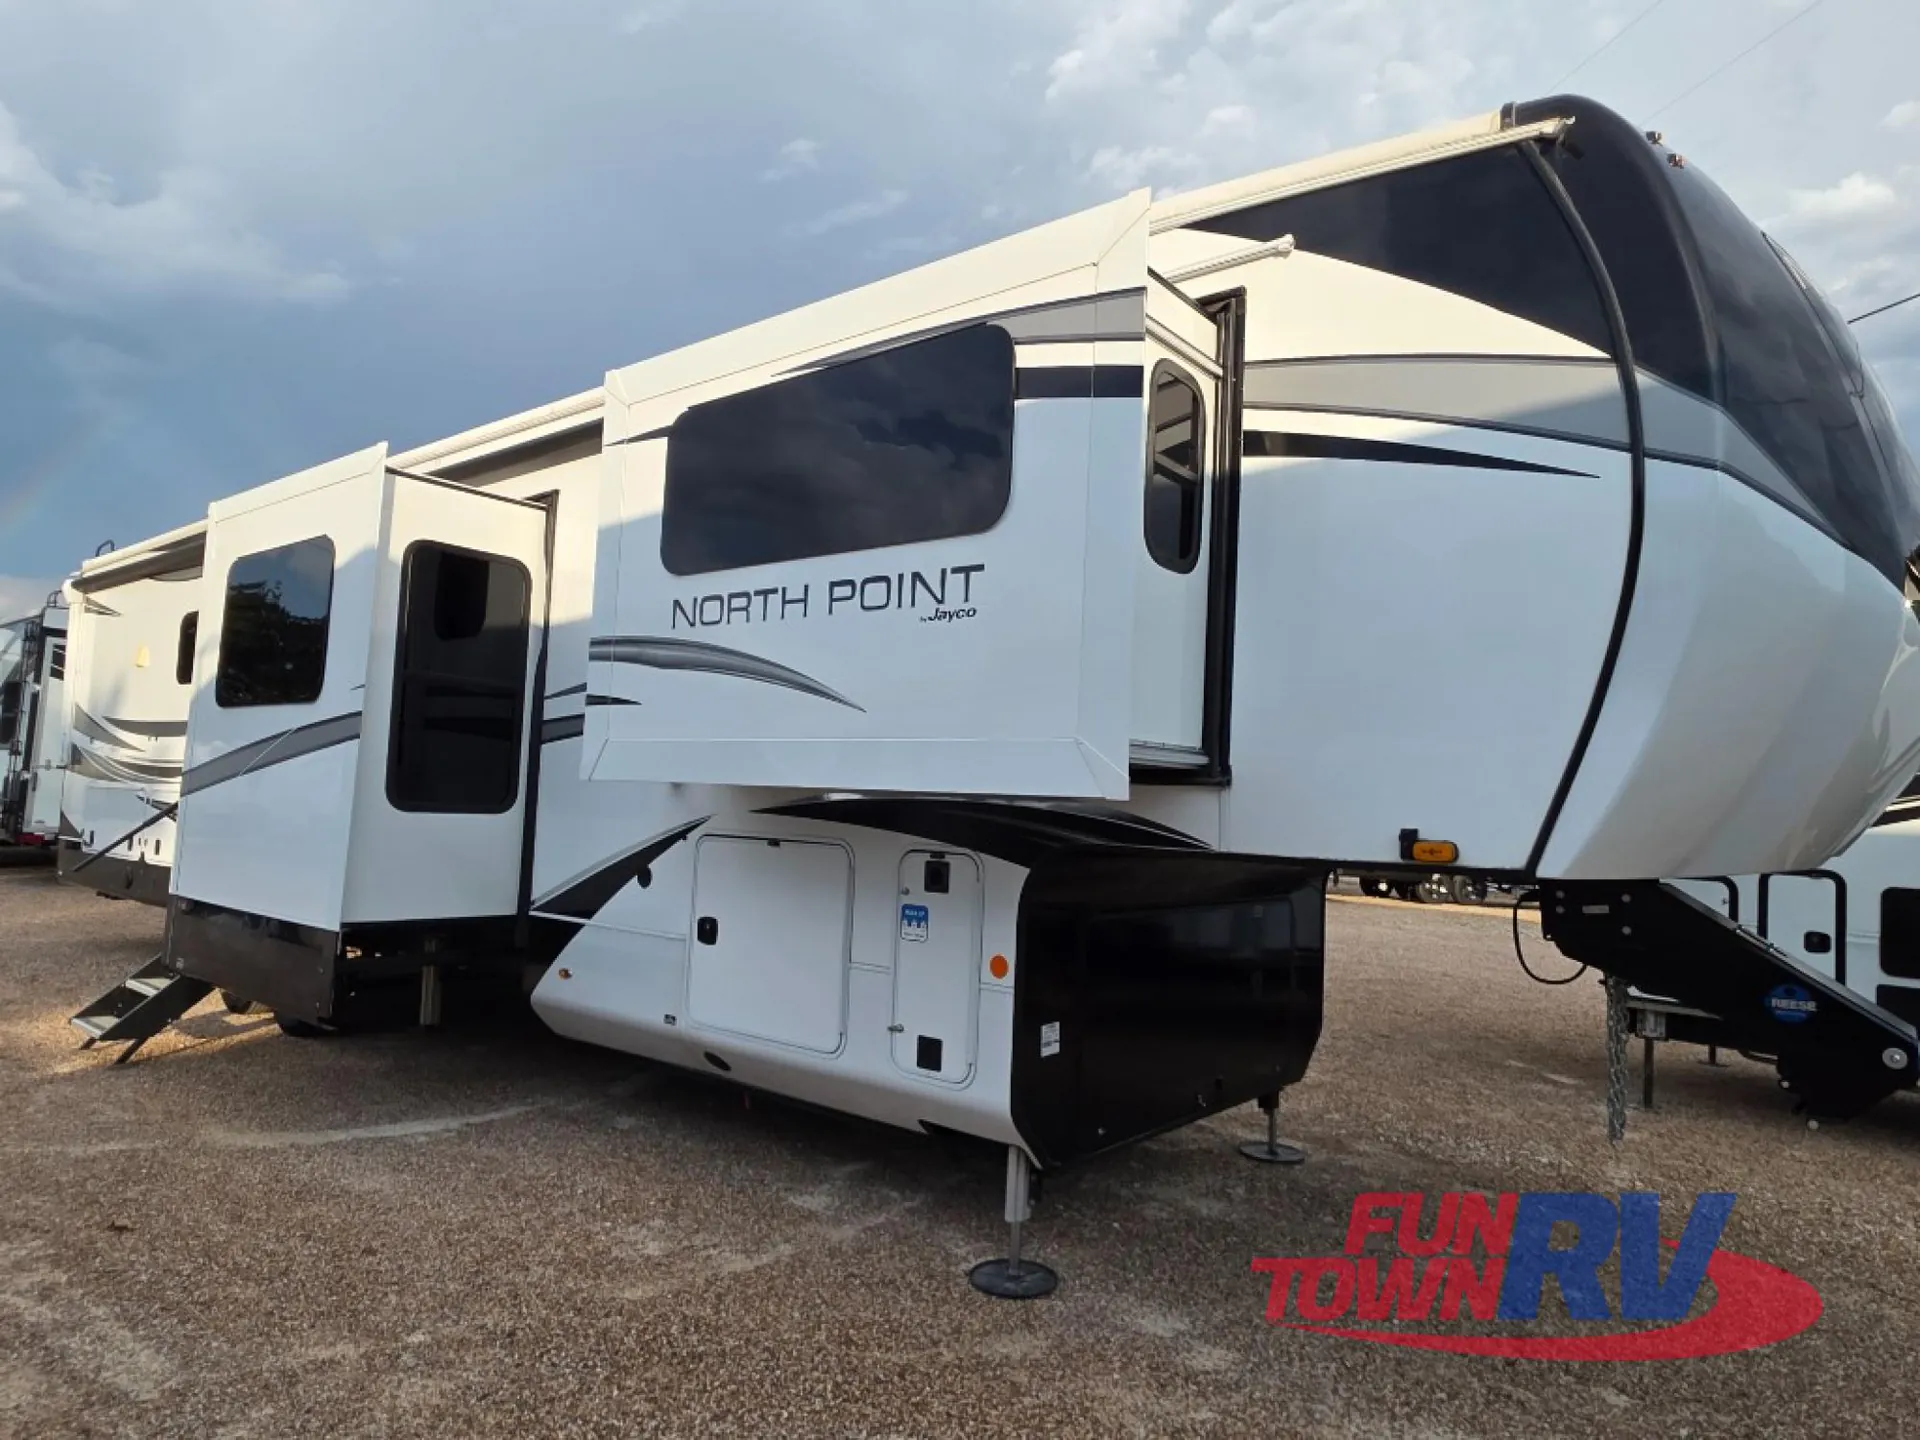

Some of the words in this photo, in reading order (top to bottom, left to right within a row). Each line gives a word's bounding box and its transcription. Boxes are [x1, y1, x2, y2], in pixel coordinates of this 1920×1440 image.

[671, 584, 809, 630] NORTH
[828, 563, 985, 616] POINT
[928, 607, 977, 622] Jayco
